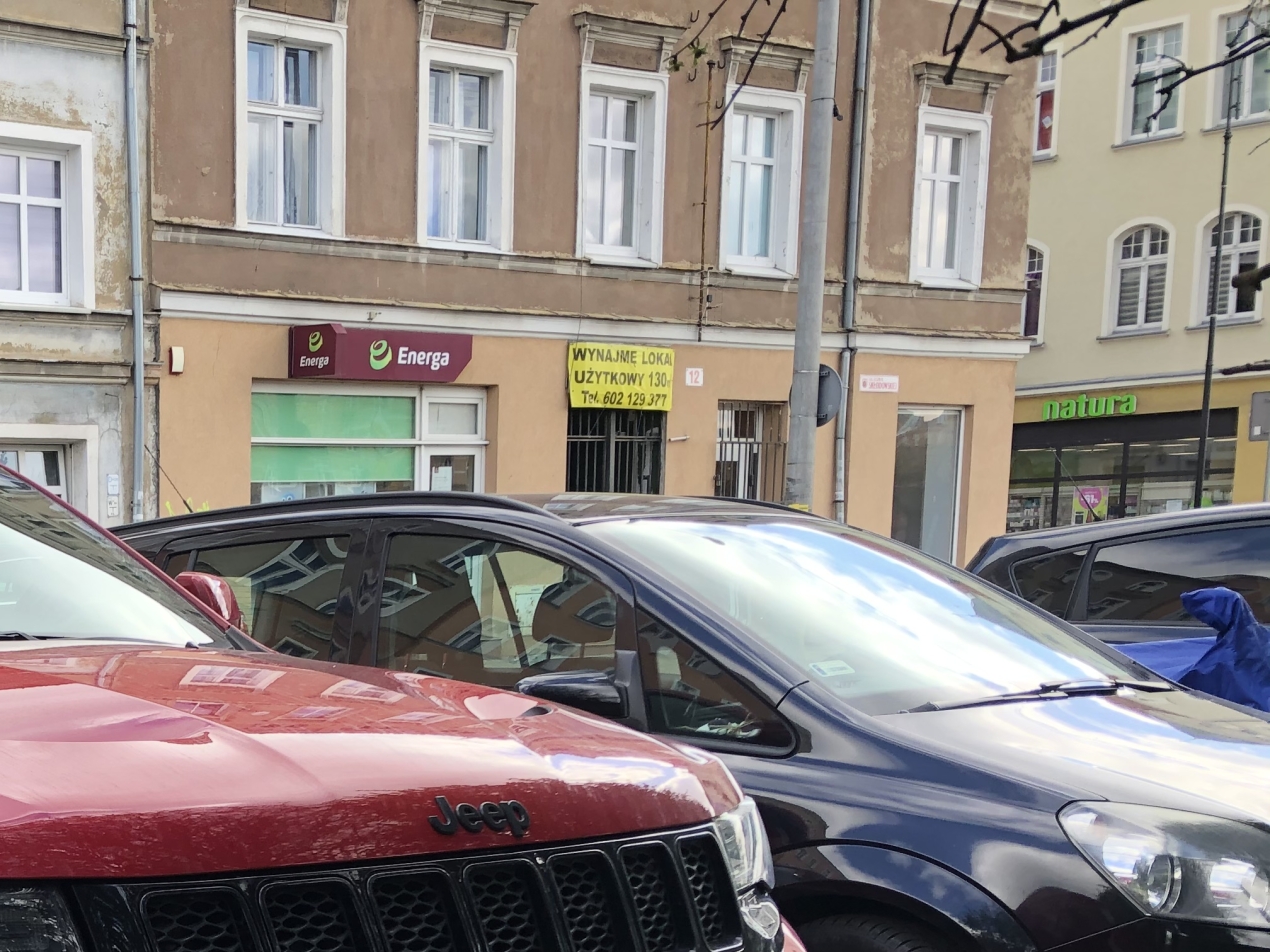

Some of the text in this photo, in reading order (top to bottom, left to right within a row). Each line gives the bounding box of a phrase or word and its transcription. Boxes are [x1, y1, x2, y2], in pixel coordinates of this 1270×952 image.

[299, 355, 330, 369] Energa
[397, 346, 450, 371] Energa
[572, 347, 637, 367] WYNAJMĘ
[574, 367, 645, 387] UŻYTKOWY
[688, 370, 700, 384] 12
[581, 390, 667, 407] Tel. 602 129 377
[1042, 393, 1137, 421] natura
[428, 795, 531, 839] Jeep
